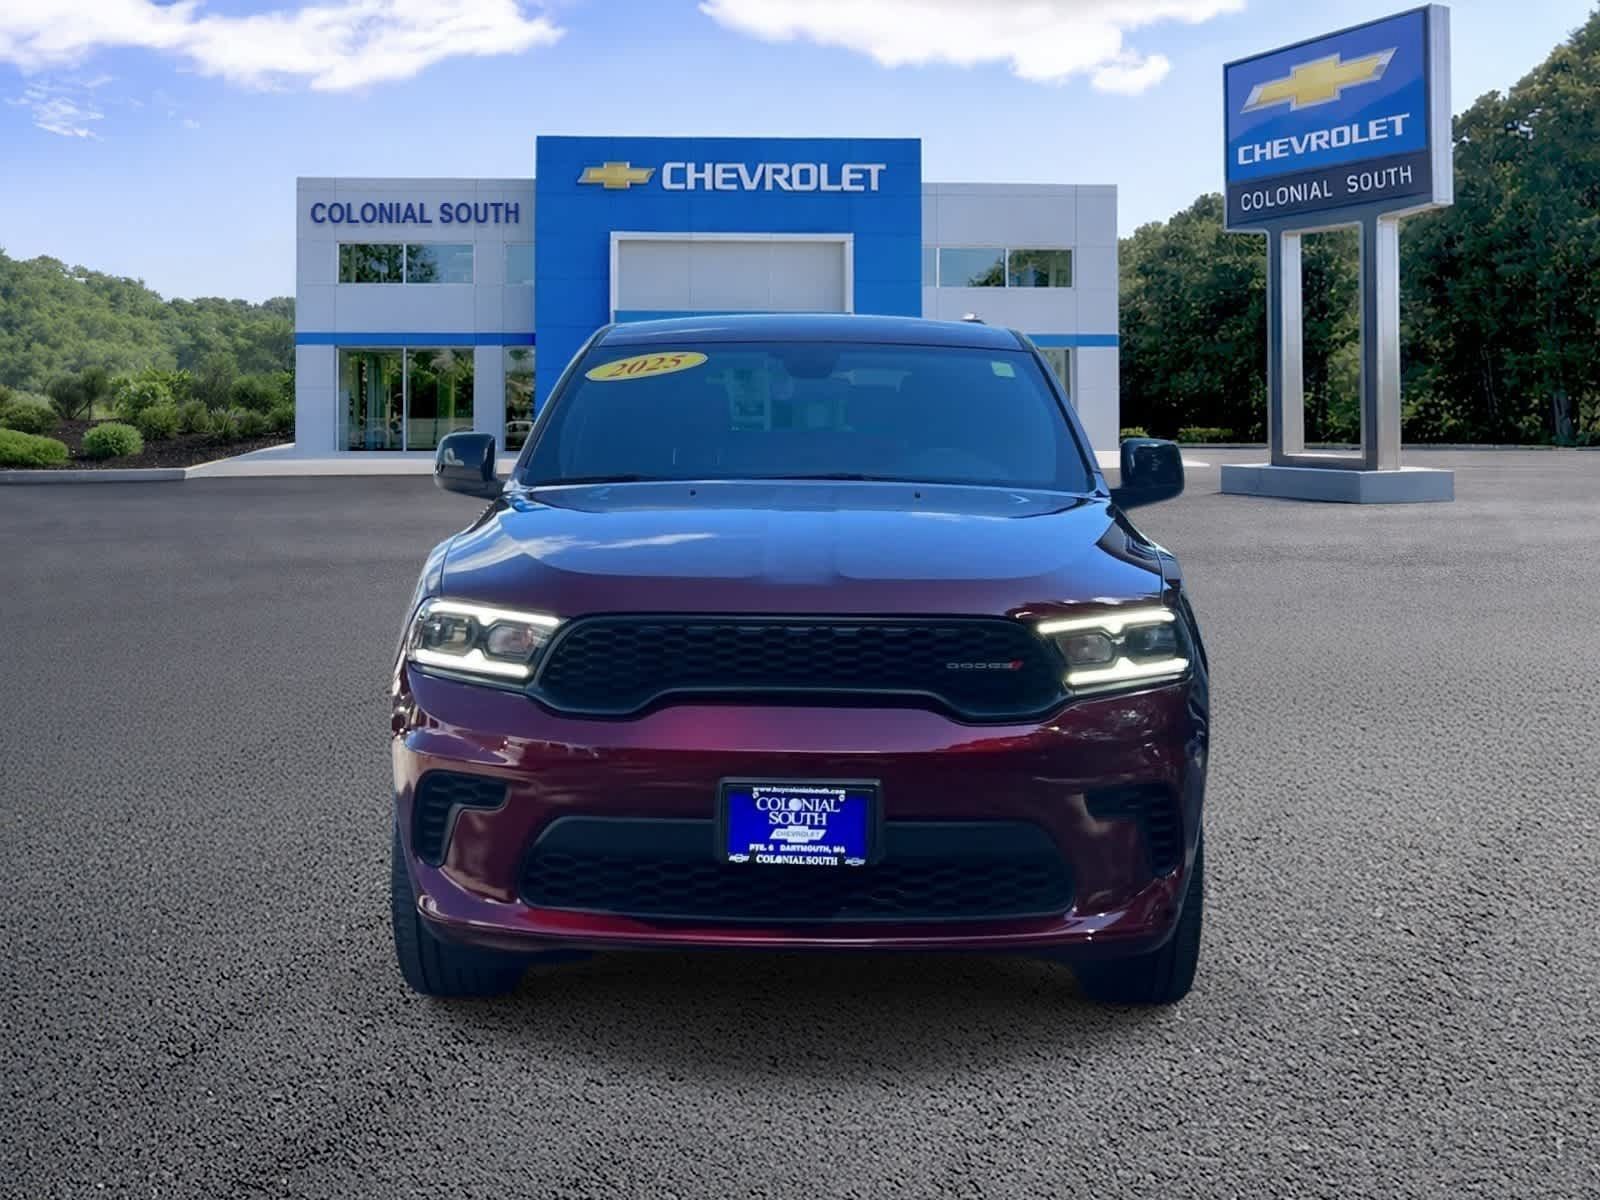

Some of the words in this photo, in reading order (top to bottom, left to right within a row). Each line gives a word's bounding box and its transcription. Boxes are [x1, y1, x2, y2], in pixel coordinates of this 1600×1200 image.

[1237, 113, 1410, 165] CHEVROLET
[662, 161, 887, 191] CHEVROLET
[1240, 180, 1333, 211] COLONIAL
[1346, 165, 1413, 193] SOUTH
[310, 202, 433, 224] COLONIAL
[439, 202, 520, 224] SOUTH
[605, 354, 689, 378] 2025
[946, 662, 1013, 670] DODGE
[756, 797, 841, 812] COLONIAL
[768, 811, 828, 826] SOUTH
[775, 829, 821, 838] CHEVROLET
[756, 854, 806, 865] COLONIAL
[806, 855, 838, 866] SOUTH
